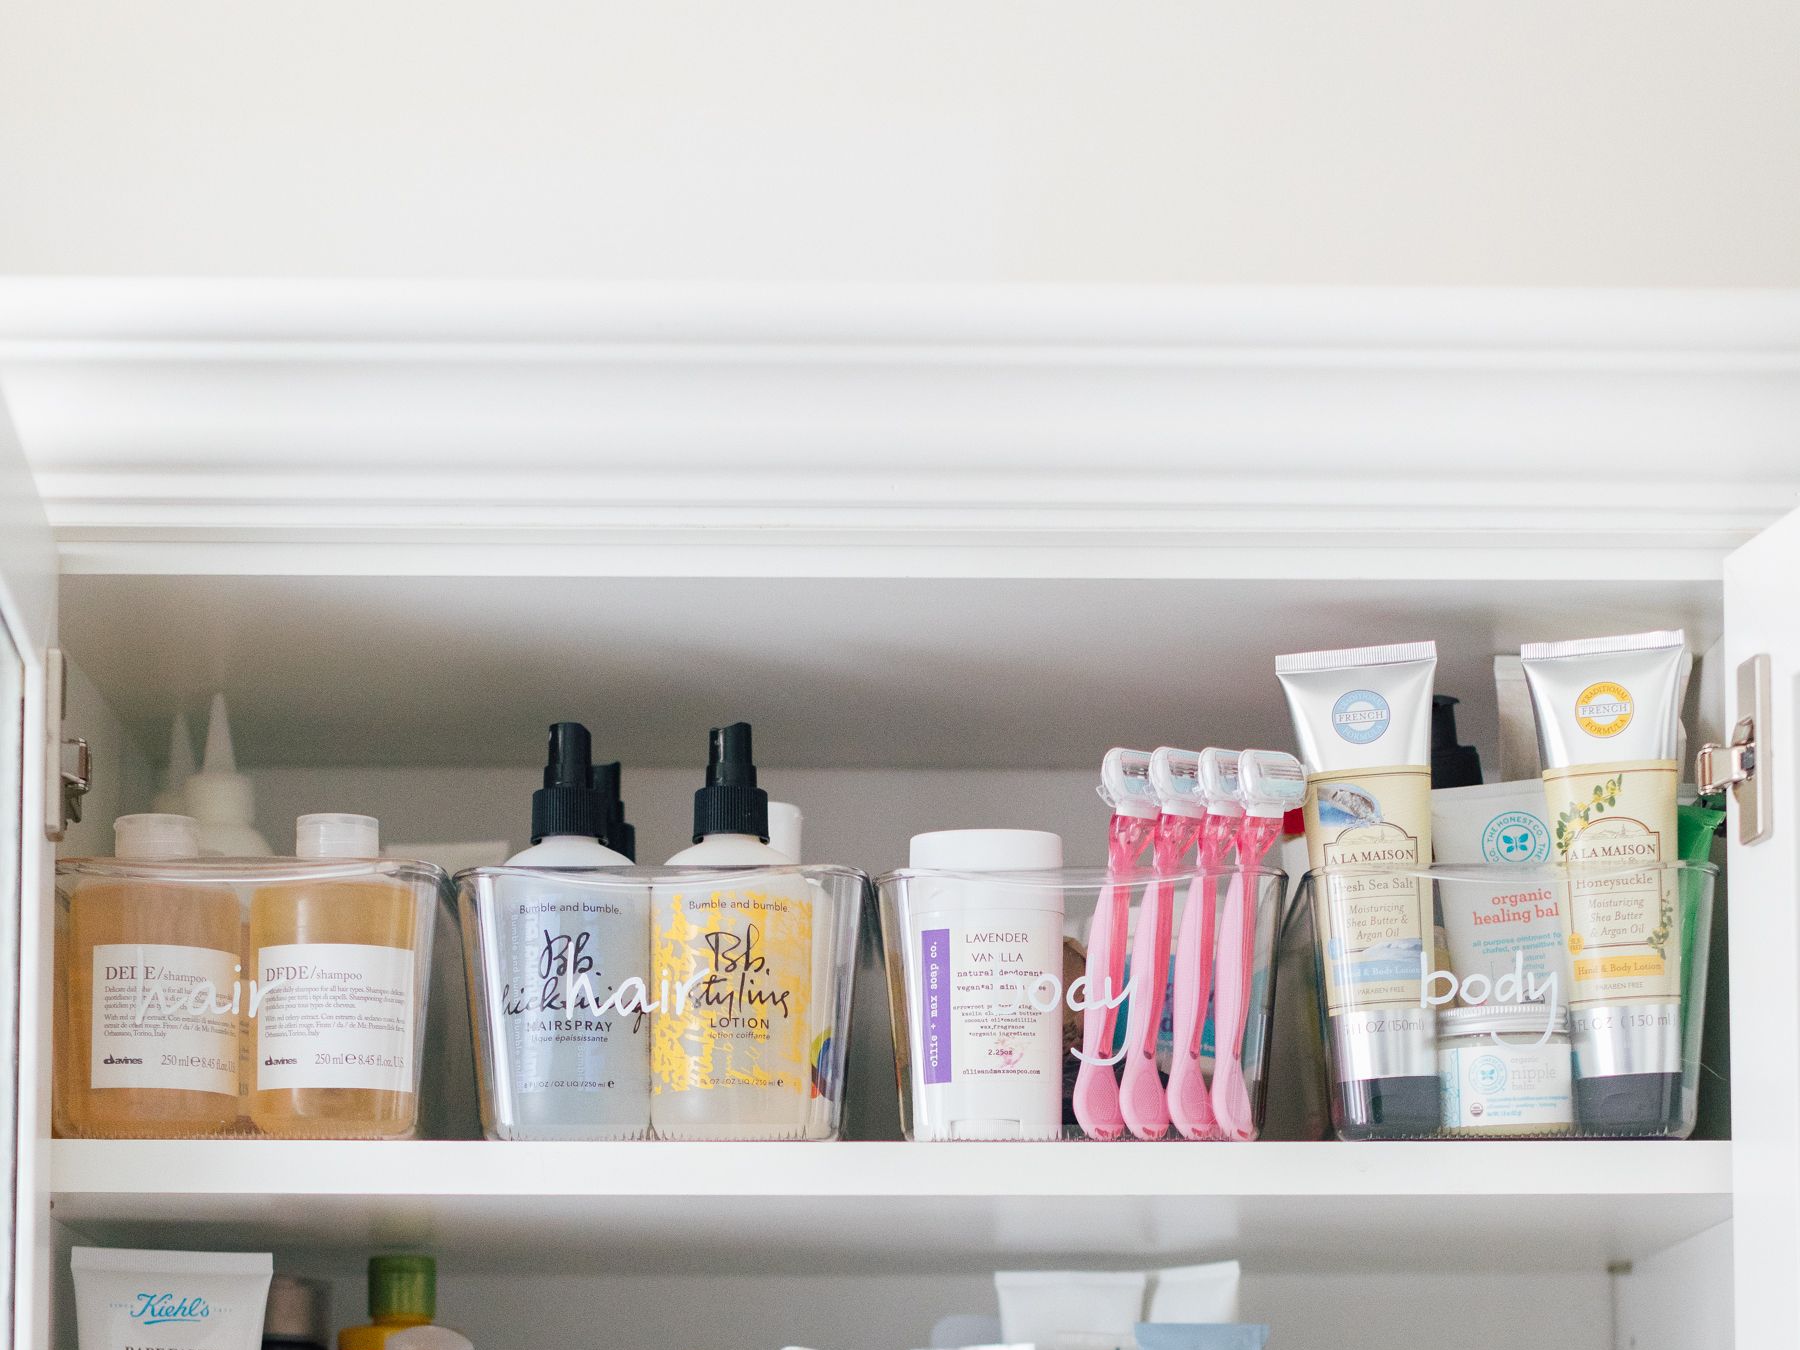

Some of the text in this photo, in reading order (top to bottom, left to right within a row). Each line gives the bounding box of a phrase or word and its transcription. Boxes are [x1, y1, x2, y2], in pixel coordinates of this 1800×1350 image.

[1338, 710, 1384, 722] FRENCH
[1581, 703, 1627, 716] FRENCH
[1585, 719, 1627, 735] FORMULA
[1497, 816, 1533, 832] HONEST
[1341, 852, 1358, 864] LA
[1361, 849, 1415, 862] MAISON
[1570, 844, 1656, 861] A LA MAISON
[1369, 878, 1388, 891] Sea
[1392, 877, 1414, 889] Salt
[1575, 873, 1653, 890] Honeysuckle
[1491, 888, 1553, 907] organic
[1589, 897, 1645, 908] Moisturizing
[519, 902, 623, 915] Bumble and bumble.
[689, 899, 791, 913] Bumble and bumble.
[1349, 903, 1405, 915] Moisturizing
[1370, 915, 1398, 926] Butter
[1400, 914, 1408, 924] &
[1472, 903, 1560, 926] healing bal
[1614, 911, 1643, 921] Butter
[965, 932, 1030, 944] LAVENDER
[1356, 927, 1400, 942] Argan Oil
[1600, 924, 1645, 939] Argan Oil
[929, 941, 939, 960] co.
[971, 952, 1025, 963] VANLLA
[956, 969, 994, 978] natural
[1610, 962, 1662, 974] Body Lotion
[565, 941, 710, 1020] hair
[929, 963, 939, 991] soap
[135, 944, 286, 1025] hair
[1627, 981, 1644, 989] FREE
[688, 972, 791, 1020] styling
[1420, 950, 1559, 1049] body
[929, 995, 939, 1018] max
[710, 1017, 771, 1030] LOTION
[735, 1031, 771, 1040] coiffante
[103, 1054, 143, 1065] davines
[161, 1055, 177, 1066] 250
[178, 1055, 189, 1067] ml
[264, 1055, 298, 1066] davines
[315, 1053, 375, 1066] 250 ml 8.45
[130, 1292, 210, 1325] Kiehl's
